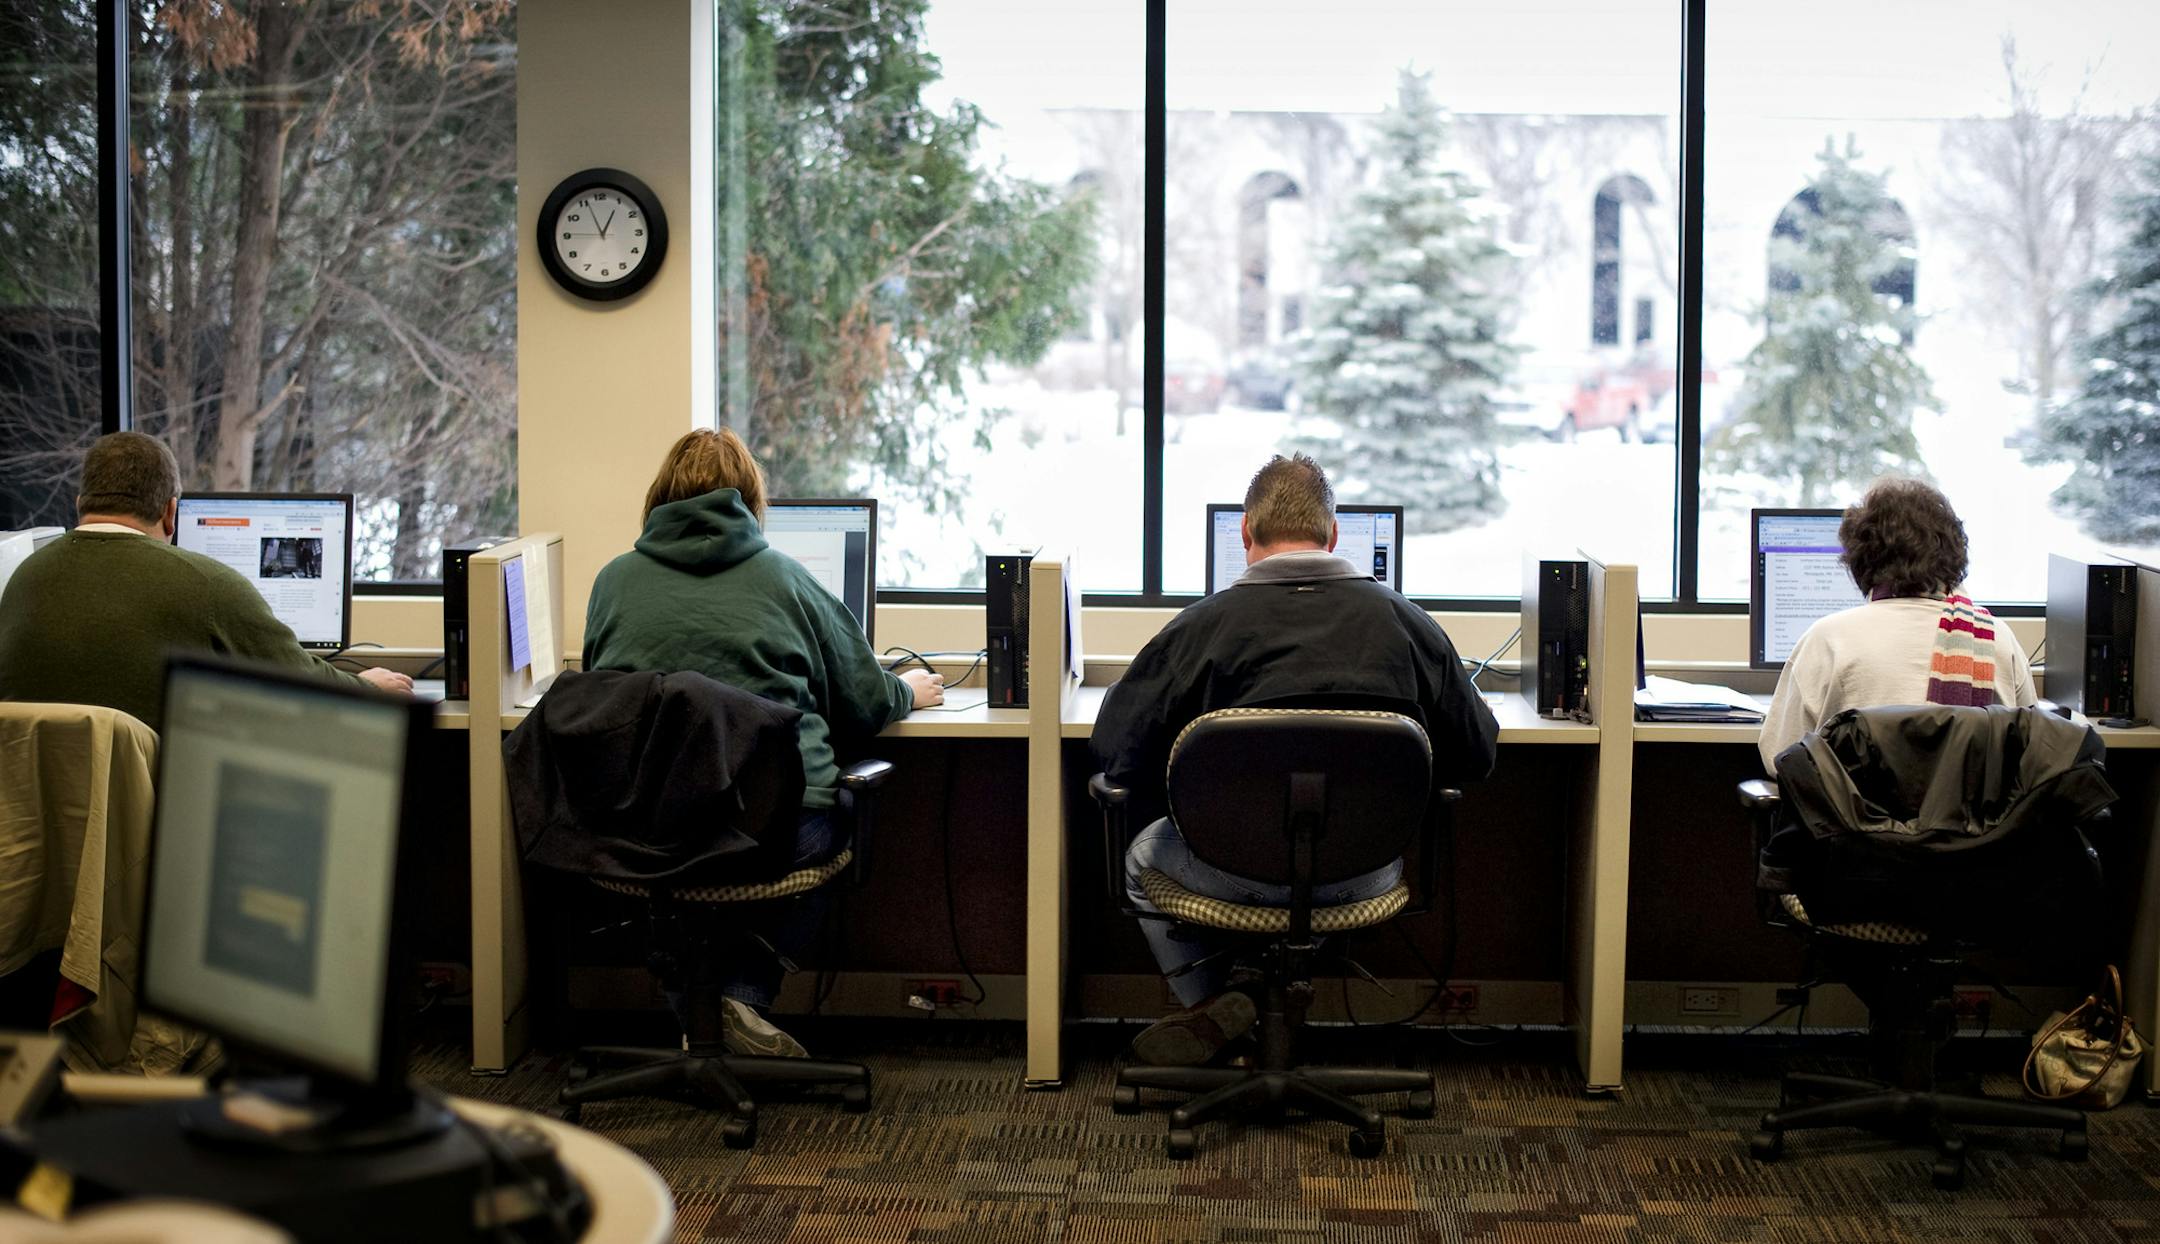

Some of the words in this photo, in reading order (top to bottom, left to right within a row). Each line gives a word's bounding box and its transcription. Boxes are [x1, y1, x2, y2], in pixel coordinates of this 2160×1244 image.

[594, 193, 607, 201] 12
[567, 214, 580, 222] 10
[563, 232, 571, 240] 9
[634, 229, 643, 237] 3
[619, 262, 627, 270] 5
